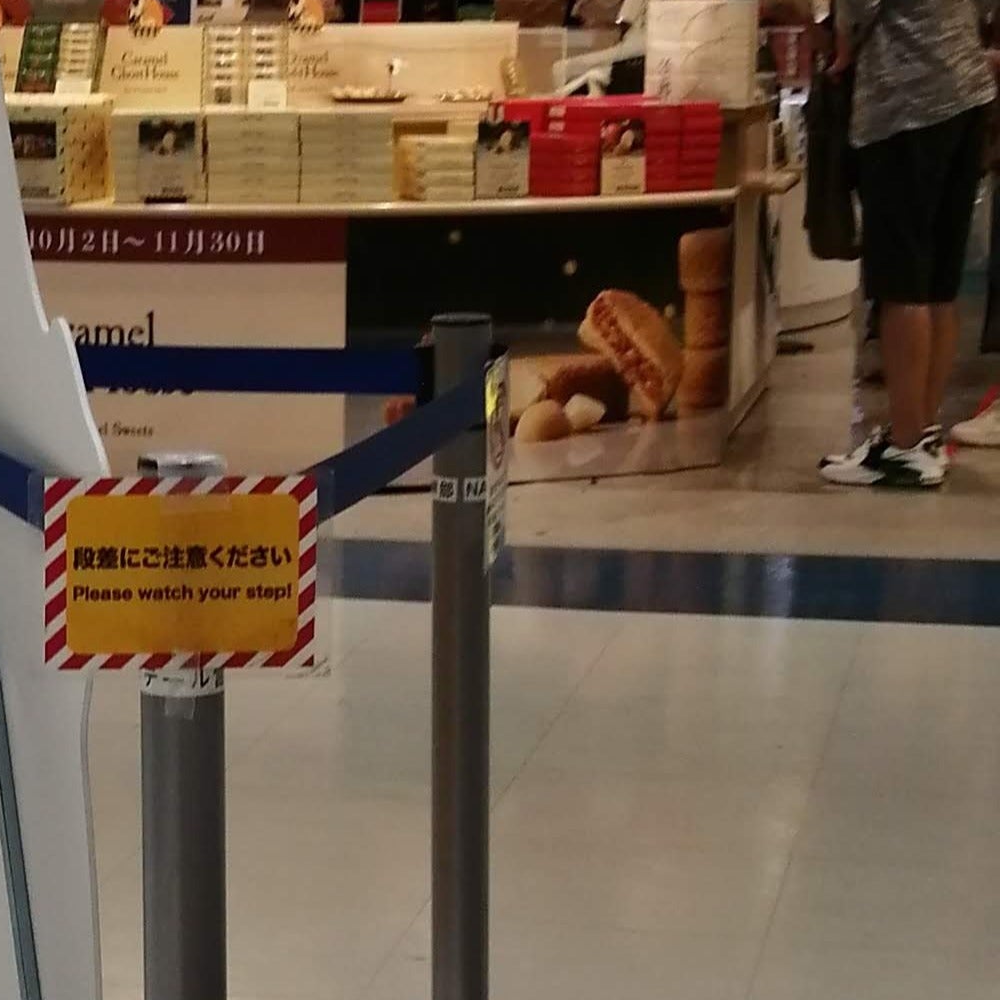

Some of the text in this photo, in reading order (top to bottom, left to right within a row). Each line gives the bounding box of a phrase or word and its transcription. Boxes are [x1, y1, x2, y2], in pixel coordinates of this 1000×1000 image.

[69, 310, 155, 347] amel
[73, 546, 292, 570] 段差にご注意ください
[73, 583, 292, 603] Please watch your step!
